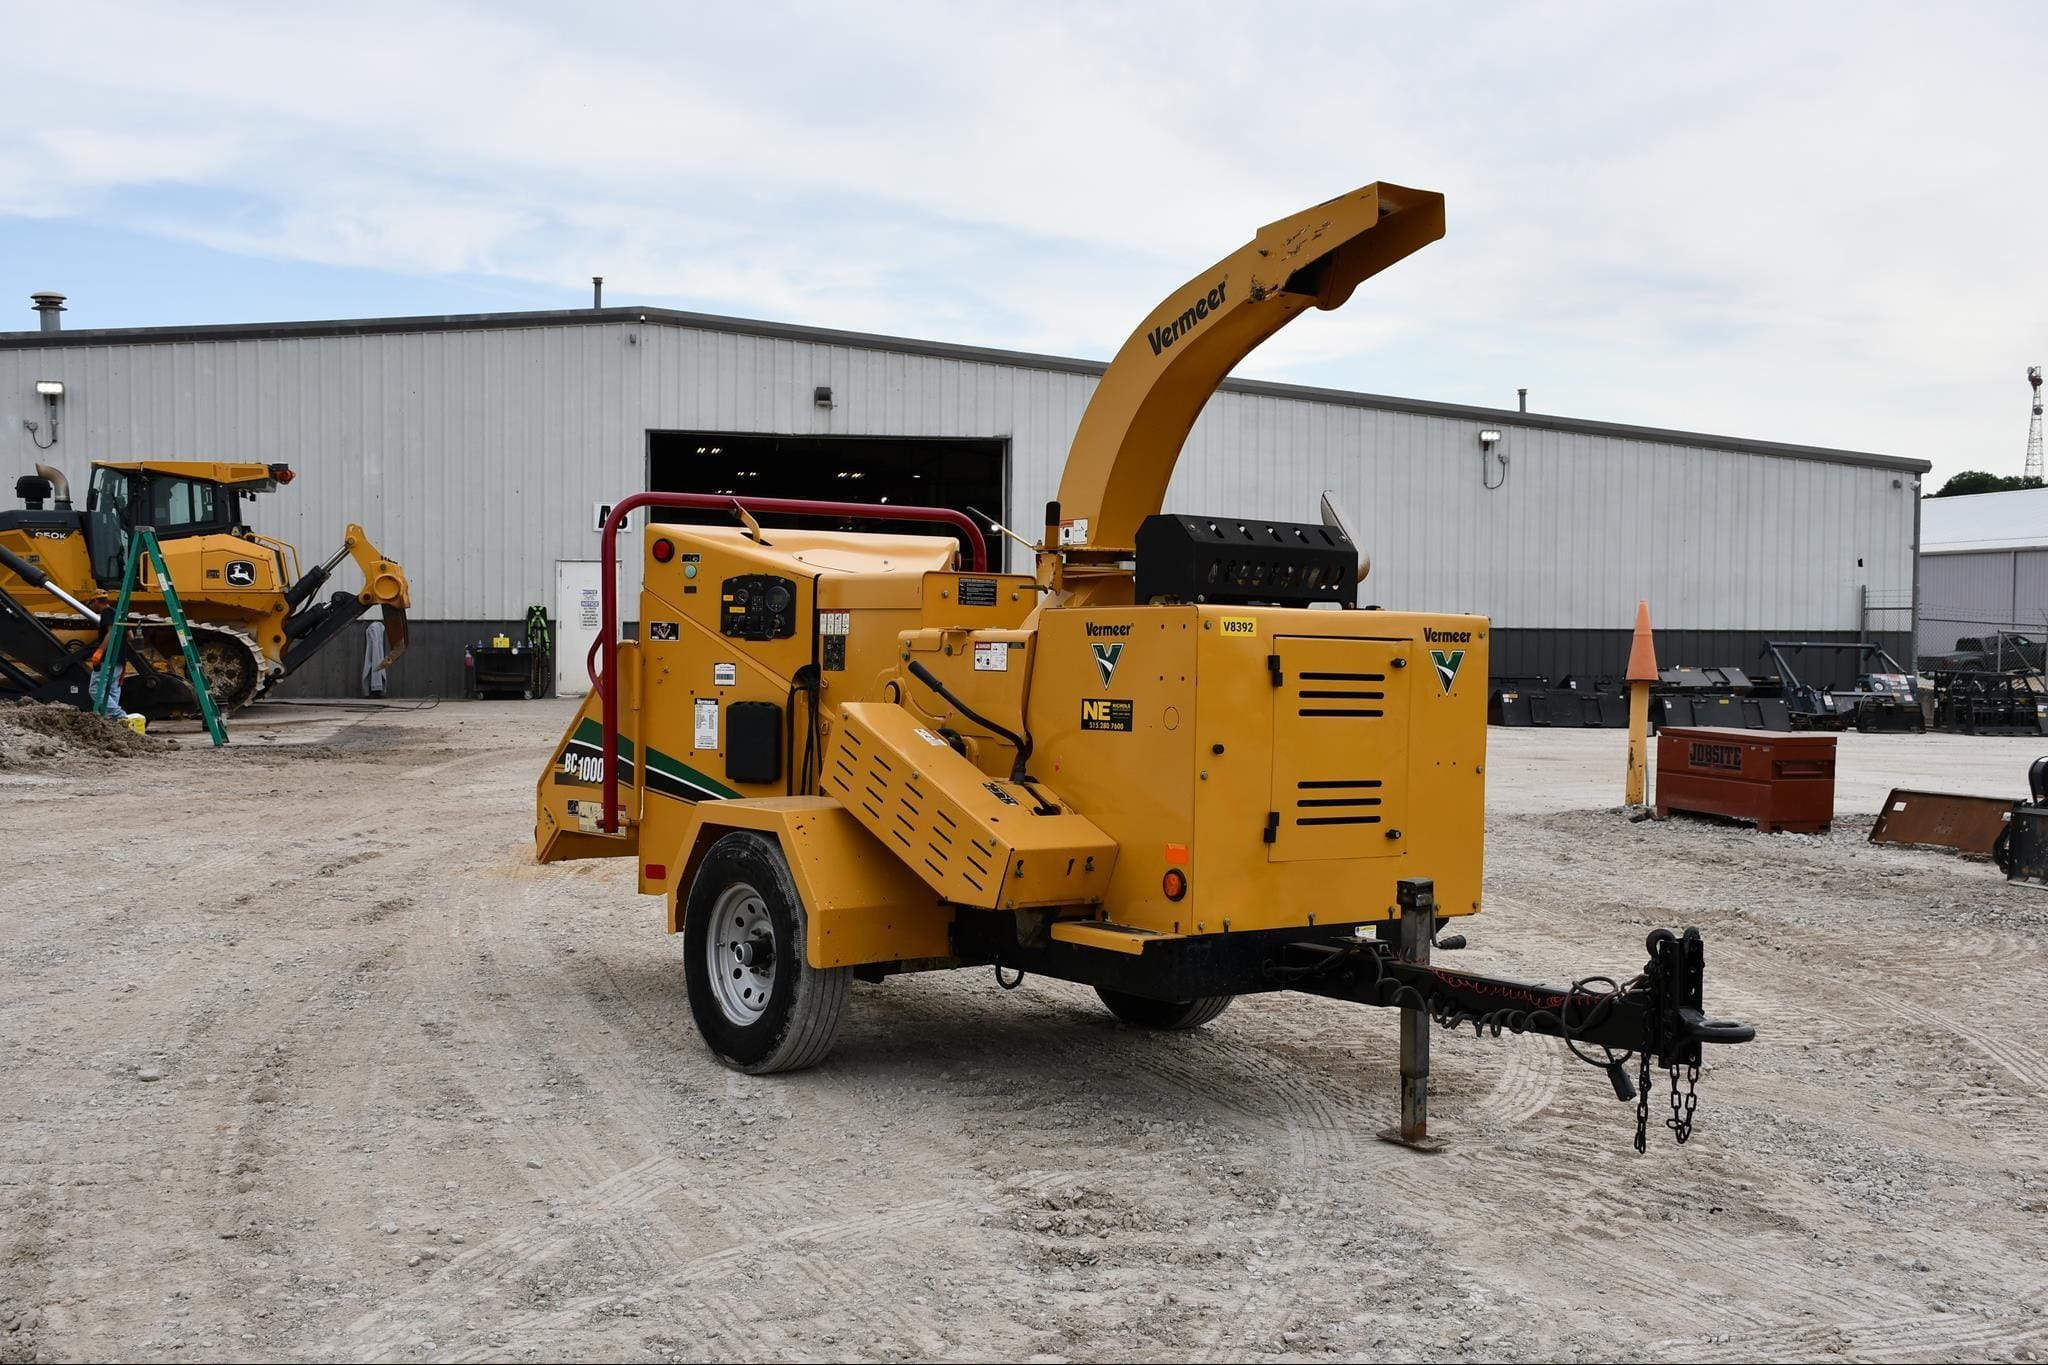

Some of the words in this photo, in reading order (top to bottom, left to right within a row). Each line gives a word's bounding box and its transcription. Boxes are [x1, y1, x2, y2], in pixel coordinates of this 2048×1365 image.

[1147, 280, 1226, 356] Vermeer
[1085, 621, 1131, 637] Vermeer
[1223, 621, 1254, 632] V8392
[1423, 627, 1472, 643] Vermeer
[1083, 700, 1111, 721] NE
[1690, 743, 1742, 765] JOBSITE
